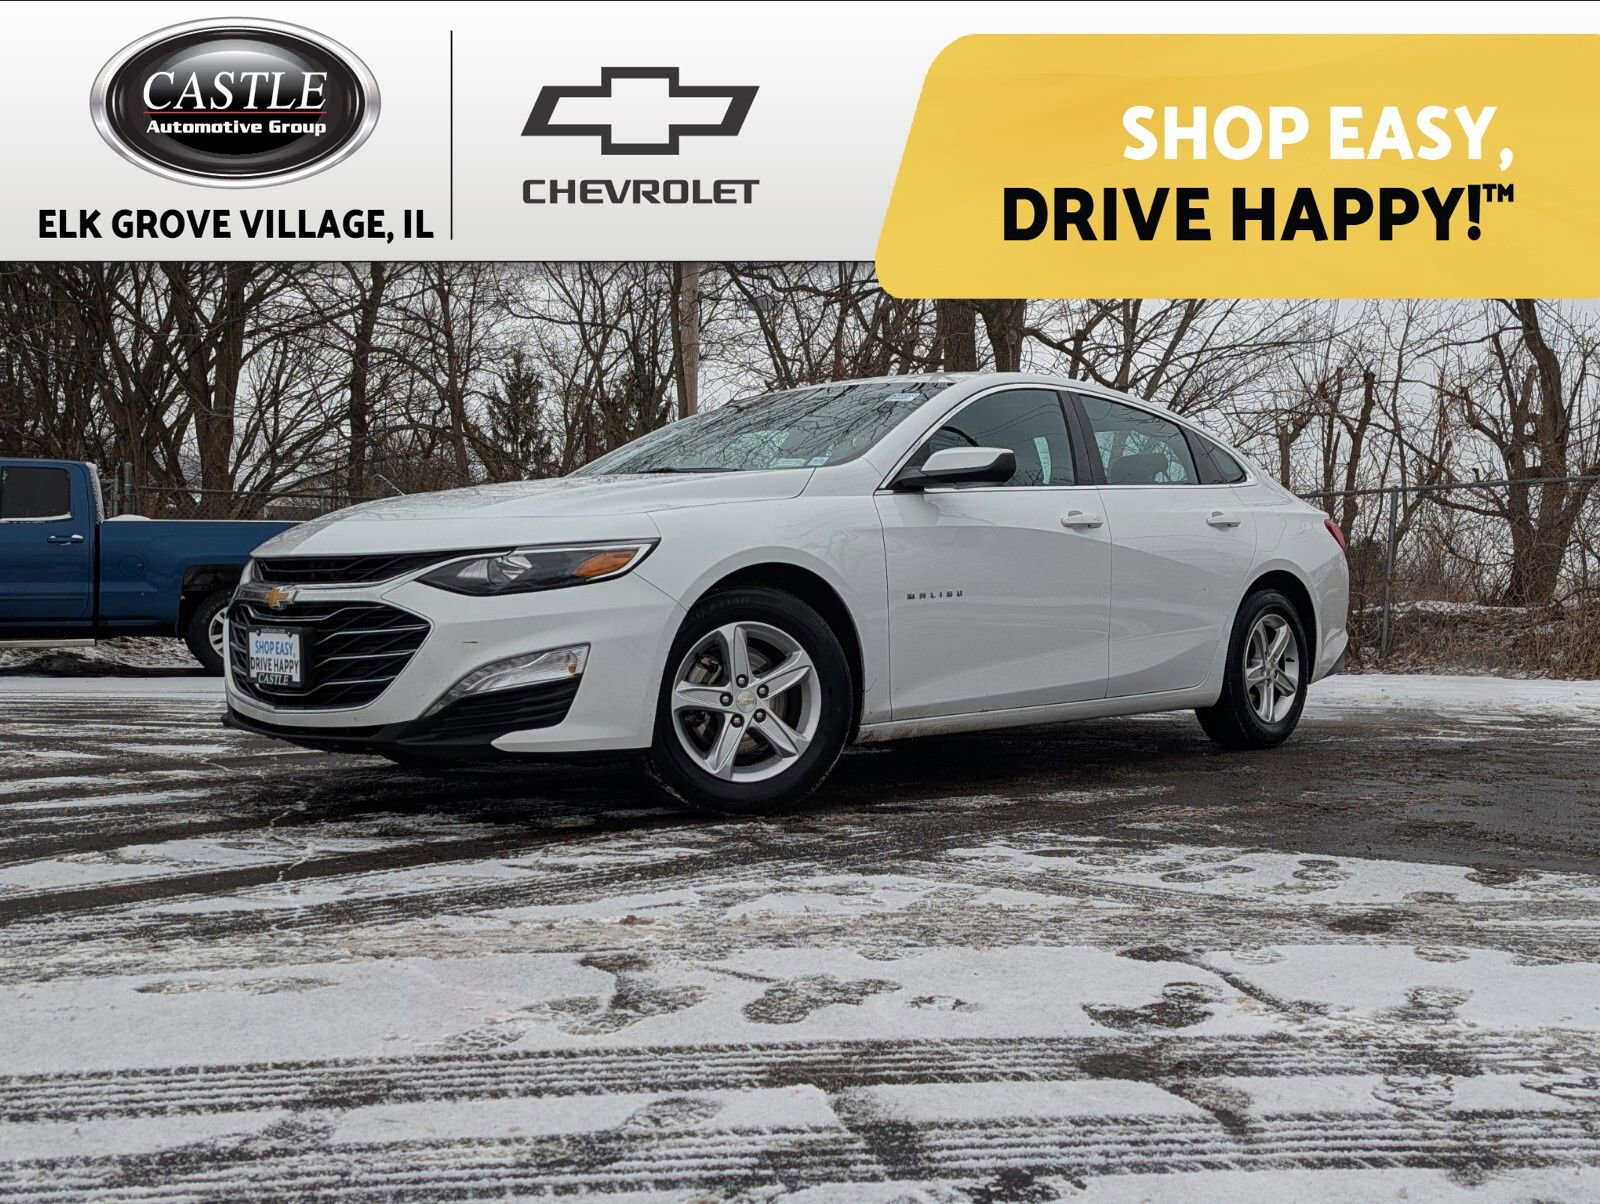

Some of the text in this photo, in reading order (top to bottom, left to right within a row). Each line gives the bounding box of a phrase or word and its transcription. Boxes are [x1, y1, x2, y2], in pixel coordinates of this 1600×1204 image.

[906, 590, 964, 600] MALIBU
[255, 640, 296, 658] SHOP EASY,
[250, 657, 299, 674] DRIVE HAPPY
[257, 673, 290, 686] CASTLE
